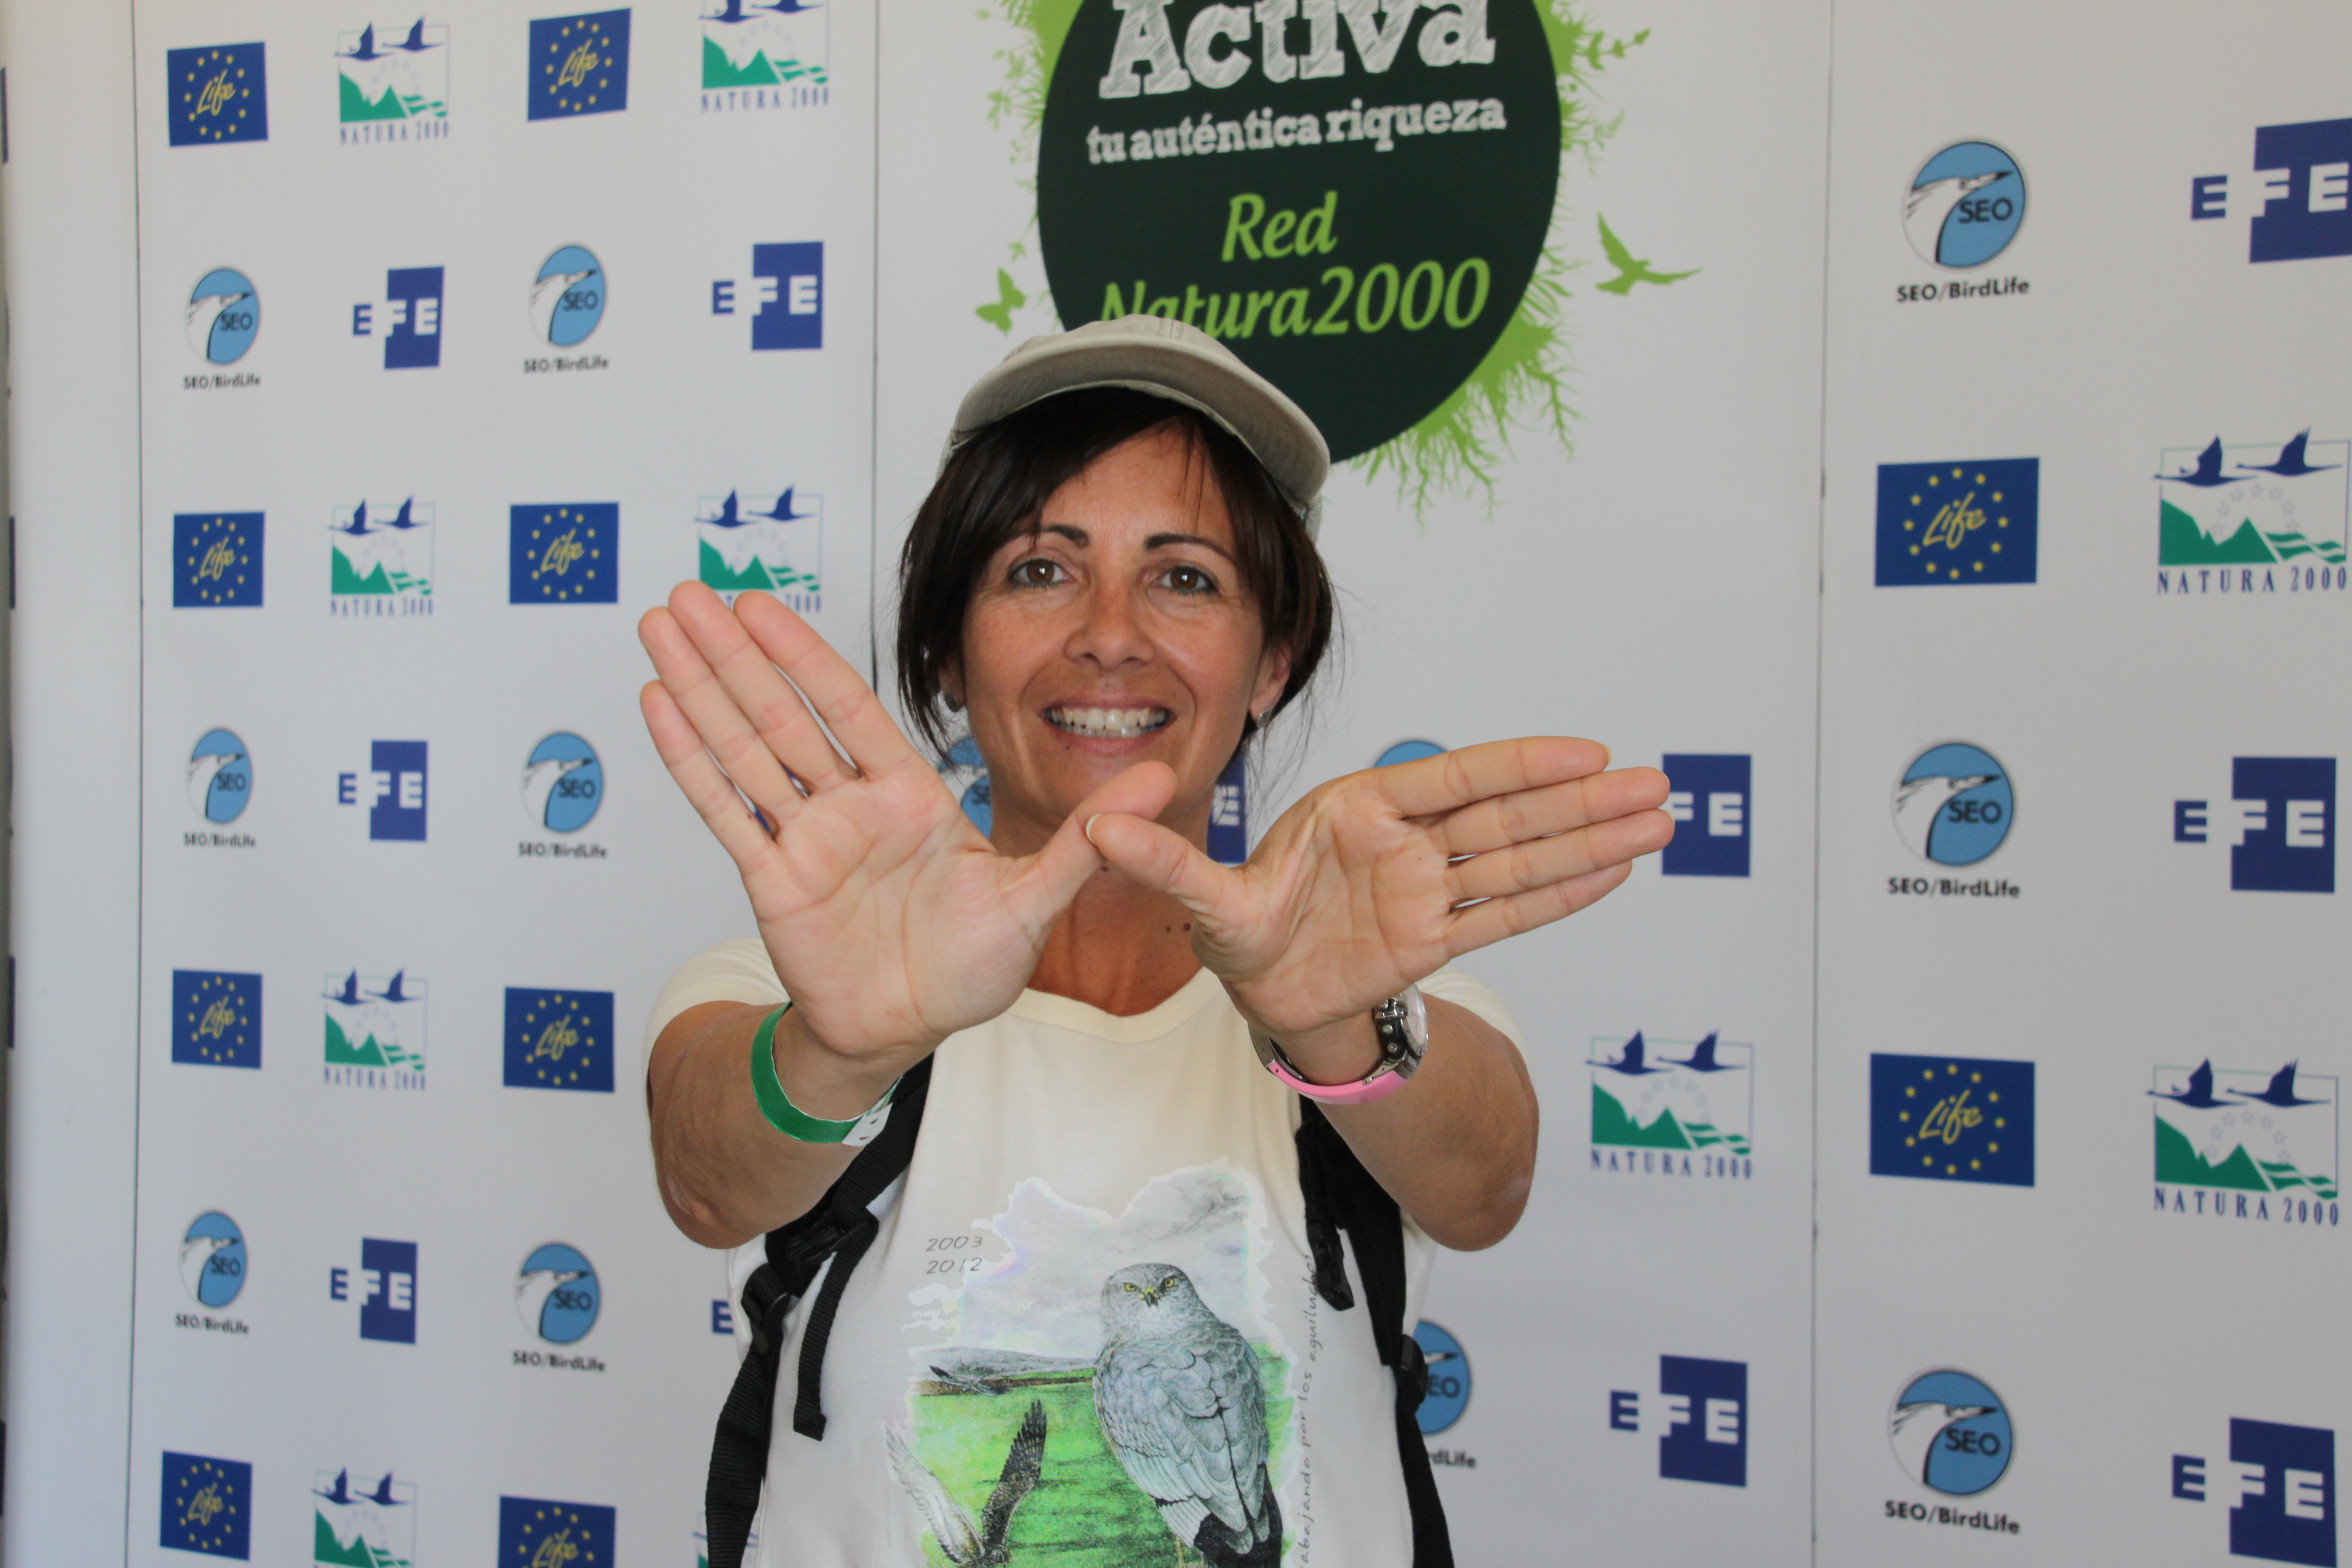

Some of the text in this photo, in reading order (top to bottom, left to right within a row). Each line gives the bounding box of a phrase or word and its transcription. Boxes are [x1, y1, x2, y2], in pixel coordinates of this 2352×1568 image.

[558, 39, 599, 87] Life
[1099, 0, 1497, 99] Activa
[197, 69, 236, 116] Life
[701, 87, 830, 113] NATURA 2000
[339, 119, 449, 146] NATURA 2000
[1087, 98, 1507, 164] tu auténtica riqueza
[2191, 162, 2350, 221] EFE
[1221, 190, 1338, 262] Red
[1958, 198, 2013, 224] SEO
[562, 292, 599, 313] SEO
[712, 275, 818, 316] EFE
[1897, 276, 2031, 302] SEO/BirdLife
[220, 311, 254, 332] SEO
[352, 298, 439, 337] EFE
[184, 374, 261, 390] SEO/BirdLife
[1922, 491, 1988, 549] Life
[199, 536, 236, 580] Life
[541, 528, 585, 575] Life
[2156, 565, 2348, 595] NATURA 2000
[330, 597, 434, 617] NATURA 2000
[216, 773, 247, 792] SEO
[338, 771, 423, 809] EFE
[558, 780, 597, 801] SEO
[1948, 801, 2002, 824] SEO
[2174, 799, 2325, 848] EFE
[184, 833, 256, 848] SEO/BirdLife
[1888, 877, 2020, 898] SEO/BirdLife
[200, 997, 236, 1039] Life
[535, 1015, 580, 1060] Life
[324, 1067, 427, 1091] NATURA 2000
[1919, 1089, 1984, 1145] Life
[1590, 1149, 1753, 1180] NATURA 2000
[2153, 1187, 2340, 1227] NATURA 2000
[926, 1236, 983, 1252] 2003
[210, 1257, 241, 1277] SEO
[926, 1257, 983, 1274] 2012
[330, 1266, 412, 1311] EFE
[554, 1289, 593, 1311] SEO
[176, 1314, 249, 1336] SEO/BirdLife
[512, 1350, 606, 1372] SEO/BirdLife
[1297, 1371, 1312, 1400] los
[1427, 1374, 1461, 1399] EO
[1300, 1411, 1311, 1448] por
[1610, 1389, 1739, 1445] EFE
[1945, 1428, 2000, 1456] SEO
[2172, 1453, 2324, 1521] EFE
[187, 1482, 223, 1526] Life
[1299, 1457, 1315, 1567] abajando
[1885, 1500, 2020, 1534] SEO/BirdLife
